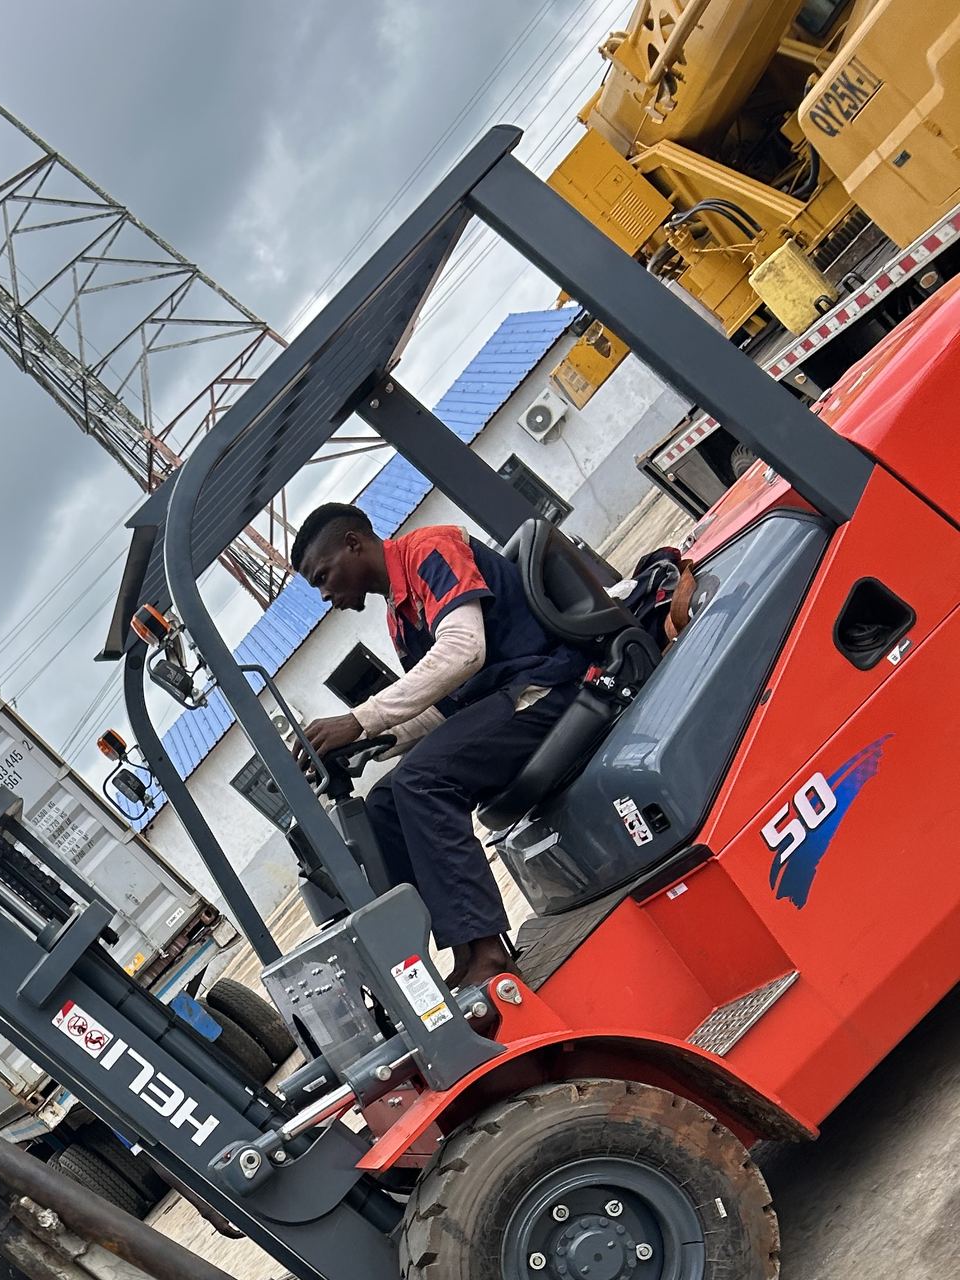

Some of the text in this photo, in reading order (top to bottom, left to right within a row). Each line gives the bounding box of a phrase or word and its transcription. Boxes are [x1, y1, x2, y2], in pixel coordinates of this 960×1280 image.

[1, 770, 22, 790] 5G1
[5, 750, 23, 769] 445
[22, 740, 33, 751] 2
[759, 771, 837, 866] 50
[99, 1038, 220, 1147] HELI
